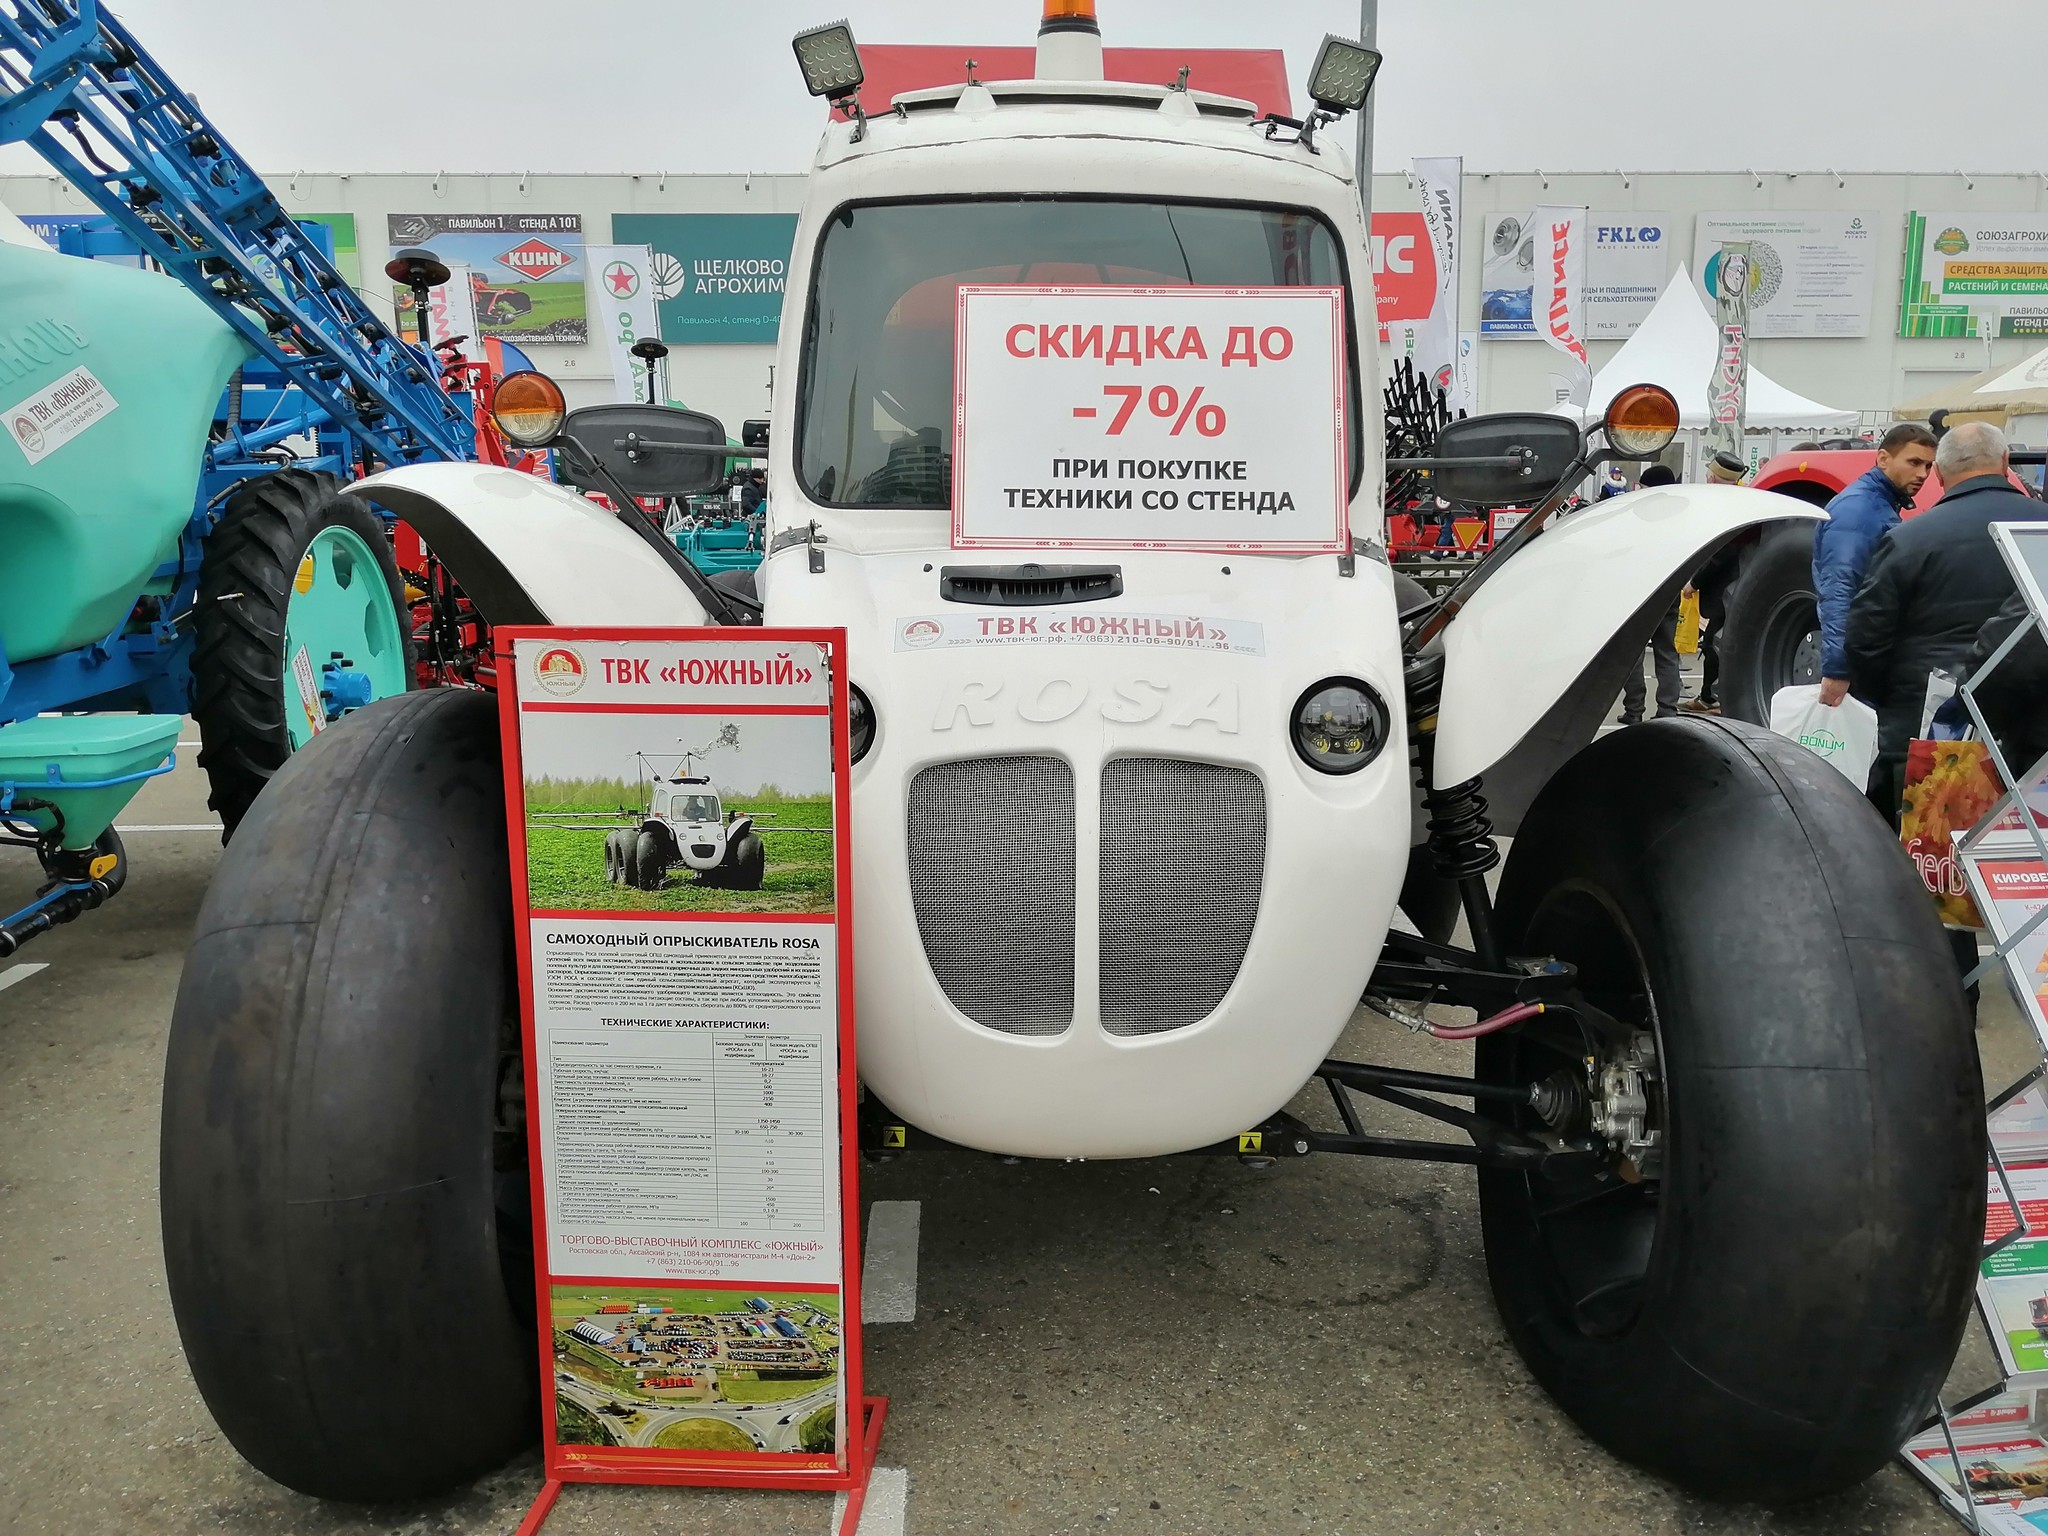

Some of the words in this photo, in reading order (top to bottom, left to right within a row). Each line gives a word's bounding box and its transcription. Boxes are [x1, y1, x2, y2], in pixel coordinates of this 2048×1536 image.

[448, 217, 496, 229] ПАВИЛЬОН
[519, 217, 548, 230] СТЕНД
[558, 216, 577, 229] 101
[1597, 227, 1636, 243] FKL
[508, 251, 563, 266] KUHN
[694, 259, 784, 277] ЩЕЛКОВО
[1949, 265, 2001, 276] СРЕДСТВА
[694, 278, 785, 294] АГРОХИМ
[1606, 286, 1657, 294] ПОДШИПНИКИ
[1948, 280, 1999, 292] РАСТЕНИЙ
[2001, 282, 2009, 291] И
[1593, 295, 1657, 303] СЕЛЬХОЗТЕХНИКИ
[677, 316, 721, 325] Павильон
[722, 316, 730, 325] 4,
[732, 316, 761, 326] стенд
[2013, 318, 2042, 329] СТЕНД
[1004, 323, 1209, 367] СКИДКА
[1220, 326, 1294, 368] ДО
[564, 359, 576, 367] 2.6
[28, 400, 54, 423] ТВК
[1072, 384, 1227, 437] -7%
[1052, 458, 1108, 479] ПРИ
[1117, 459, 1247, 481] ПОКУПКЕ
[1003, 488, 1133, 510] ТЕХНИКИ
[1141, 490, 1179, 511] СО
[1186, 490, 1296, 516] СТЕНДА
[977, 616, 1039, 636] ТВК
[1048, 616, 1227, 642] «ЮЖНЫЙ»
[1069, 634, 1083, 643] +7
[1085, 634, 1115, 644] (863)
[600, 658, 652, 684] ТВК
[659, 652, 813, 686] «ЮЖНЫЙ»
[931, 678, 1241, 735] ROSA
[1799, 733, 1845, 753] BONUM
[546, 932, 649, 947] САМОХОДНЫЙ
[653, 935, 778, 949] ОПРЫСКИВАТЕЛЬ
[782, 937, 820, 949] ROSA
[600, 1018, 673, 1028] ТЕХНИЧЕСКИЕ
[674, 1019, 770, 1029] ХАРАКТЕРИСТИКИ:
[560, 1234, 698, 1248] ТОРГОВО-ВЫСТАВОЧНЫЙ
[701, 1239, 761, 1250] КОМПЛЕКС
[765, 1240, 824, 1252] «ЮЖНЫЙ»
[609, 1248, 627, 1256] обл.,
[628, 1248, 665, 1256] Аксайский
[667, 1250, 681, 1258] р-н,
[712, 1252, 769, 1260] автомагистрали
[786, 1253, 816, 1262] «Дон-2»
[657, 1258, 677, 1266] (863)
